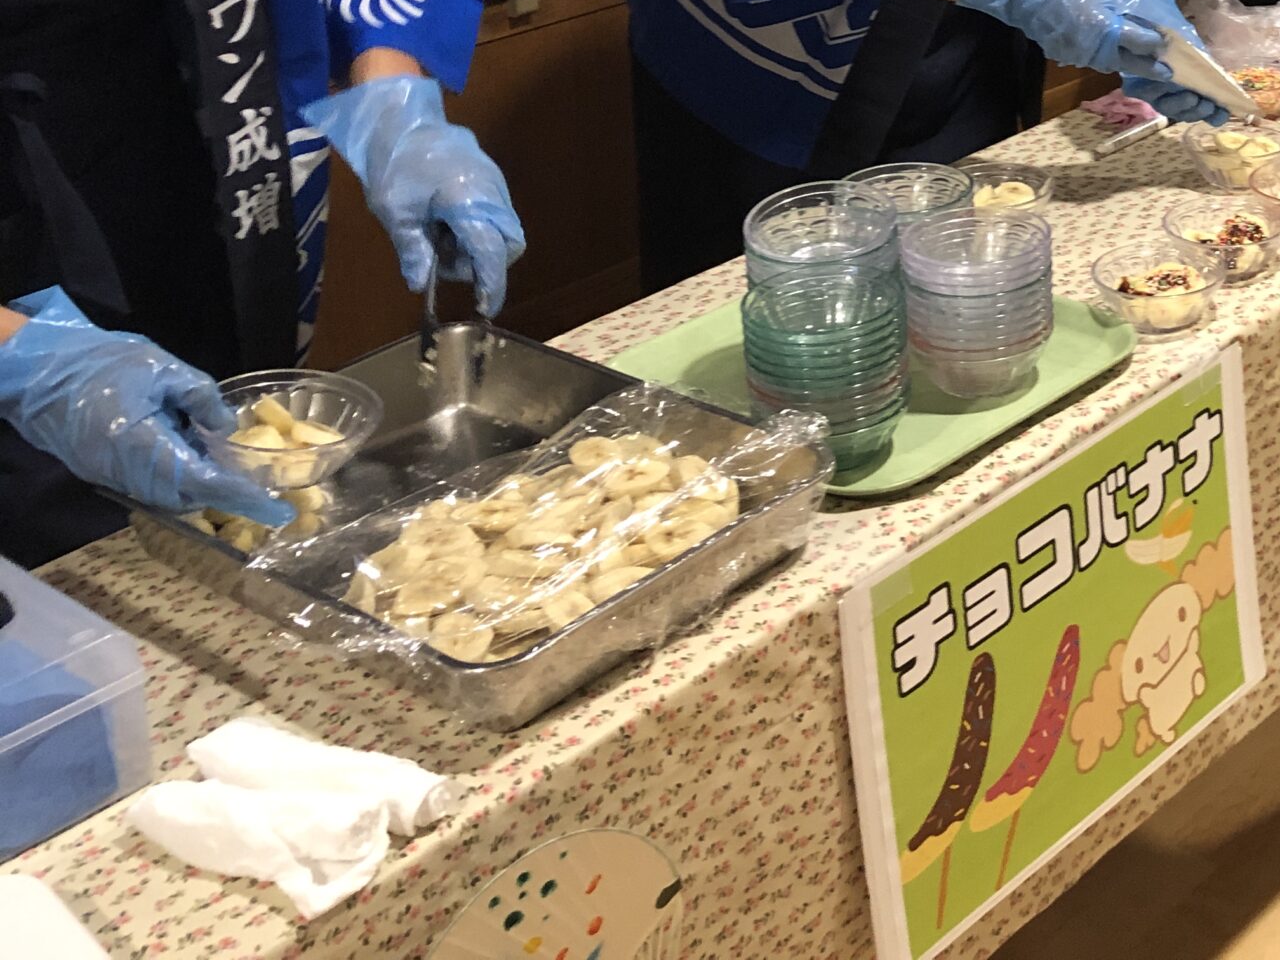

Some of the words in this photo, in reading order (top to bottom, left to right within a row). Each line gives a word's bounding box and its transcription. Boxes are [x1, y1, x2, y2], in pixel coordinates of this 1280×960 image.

[891, 407, 1224, 698] チョコバナナ
